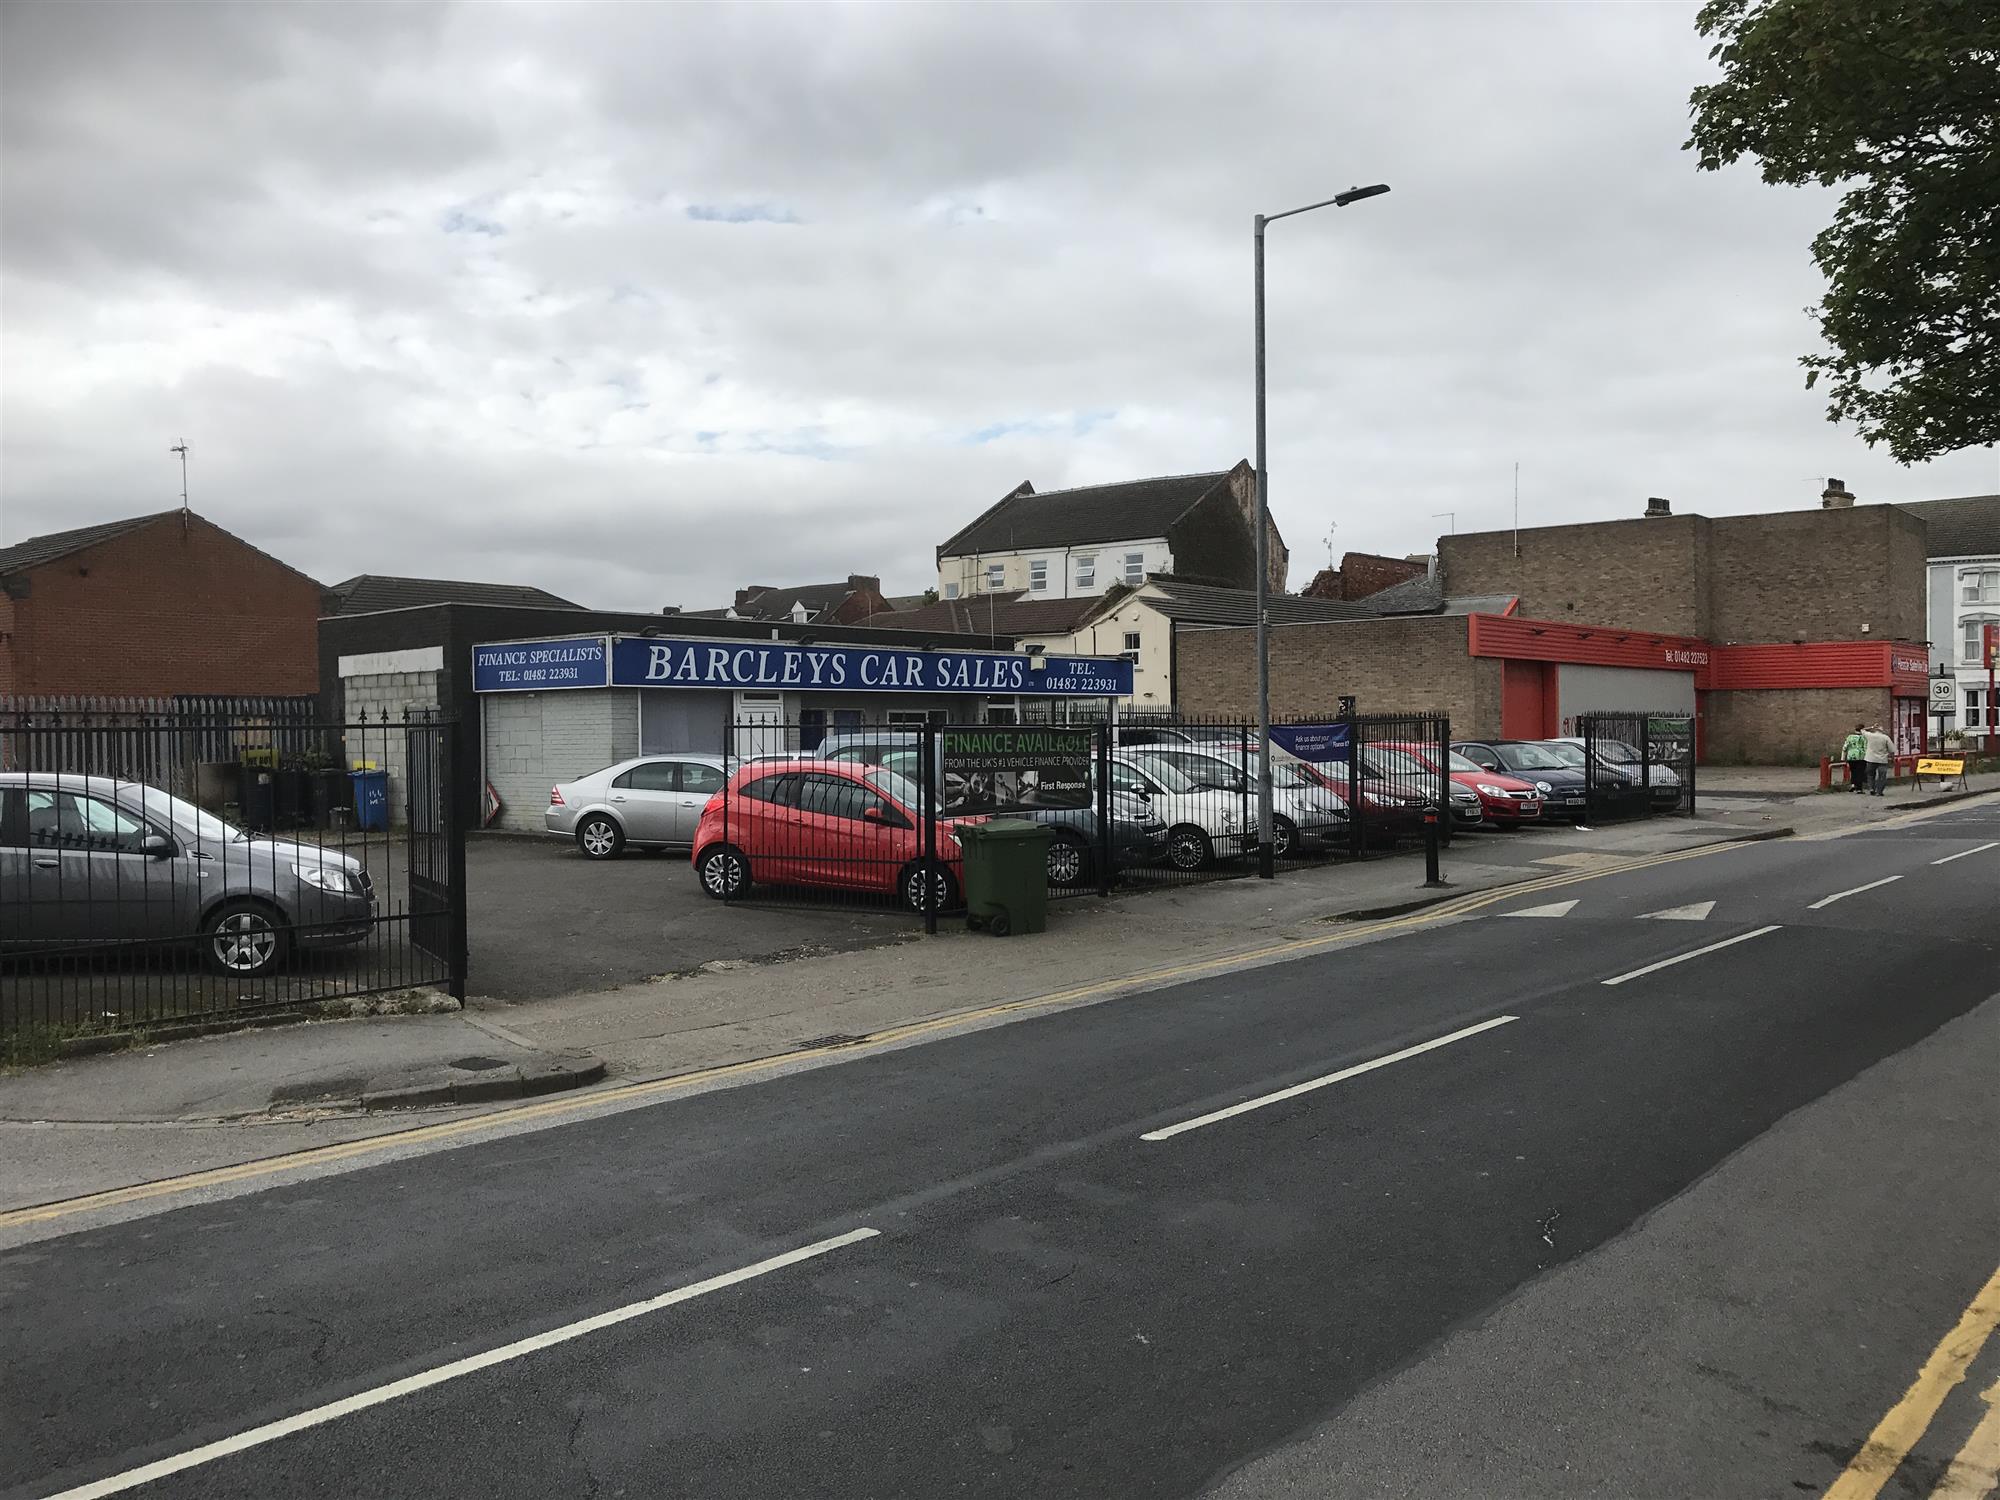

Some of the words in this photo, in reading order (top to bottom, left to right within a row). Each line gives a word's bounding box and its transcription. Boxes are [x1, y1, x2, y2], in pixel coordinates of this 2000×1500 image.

[478, 651, 526, 666] FINANCE
[529, 646, 602, 664] SPECIALISTS
[1674, 650, 1690, 664] 01482
[645, 645, 846, 685] BARCLEYS
[860, 654, 924, 687] CAR
[936, 657, 1023, 688] SALES
[1069, 662, 1096, 675] TEL:
[499, 670, 521, 682] TEL:
[523, 669, 547, 681] 01482
[549, 667, 578, 680] 223931
[1046, 677, 1077, 690] 01482
[1081, 678, 1117, 691] 223931
[1935, 685, 1949, 694] 30
[944, 734, 1013, 753] FINANCE
[944, 759, 965, 769] FROM
[967, 759, 980, 768] THE
[981, 758, 997, 768] UK'S
[1007, 757, 1034, 767] VEHICLE
[1034, 757, 1060, 767] FINANCE
[1061, 756, 1089, 766] PROVIDER
[1041, 781, 1055, 791] First
[1056, 780, 1086, 791] Response
